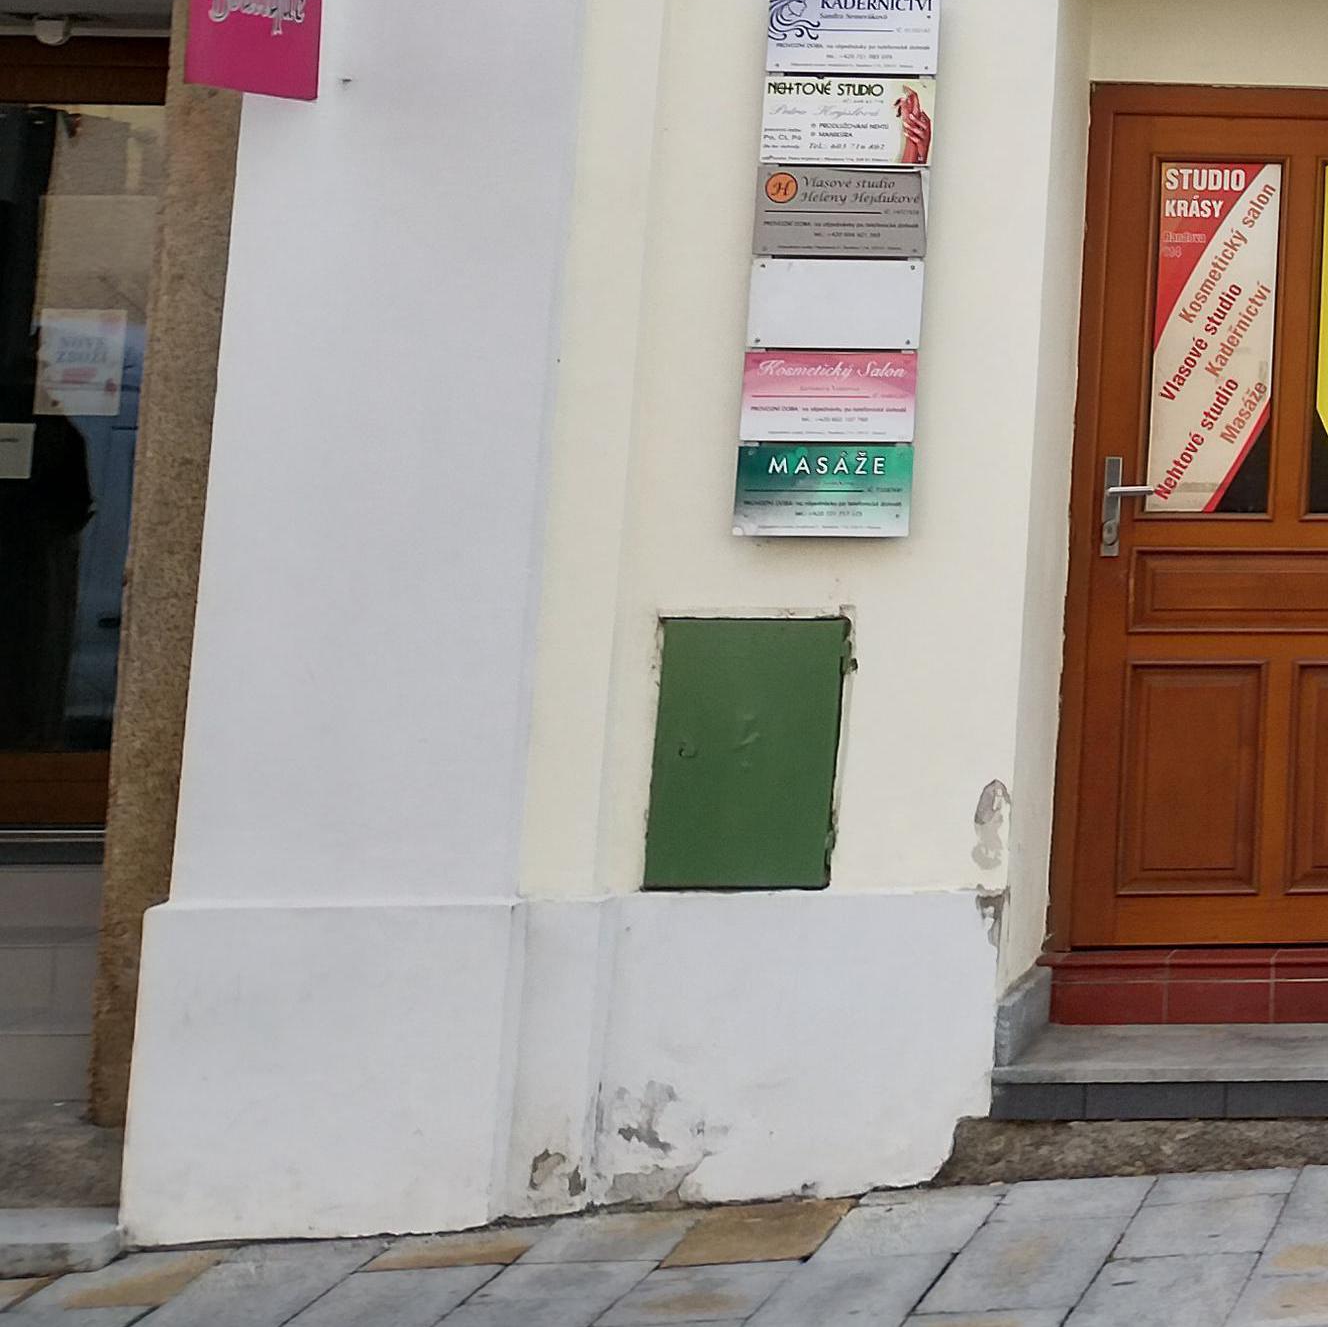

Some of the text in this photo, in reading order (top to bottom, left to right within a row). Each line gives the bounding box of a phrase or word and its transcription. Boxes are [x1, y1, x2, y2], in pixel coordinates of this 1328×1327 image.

[767, 81, 884, 97] NEHTOVÉ STUDIO
[855, 176, 895, 189] studio
[1165, 168, 1246, 191] STUDIO
[800, 190, 847, 206] Heleny
[1165, 195, 1224, 218] KRÁSY
[1178, 227, 1248, 324] Kosmetický
[1242, 183, 1277, 228] salon
[1204, 280, 1271, 377] Kadeřnictví
[1158, 283, 1242, 401] Vlasové studio
[758, 359, 906, 381] Kosmetický Salon
[1220, 382, 1267, 444] Masáže
[1154, 378, 1239, 500] Nehtové studio
[768, 451, 887, 475] MASÁŽE
